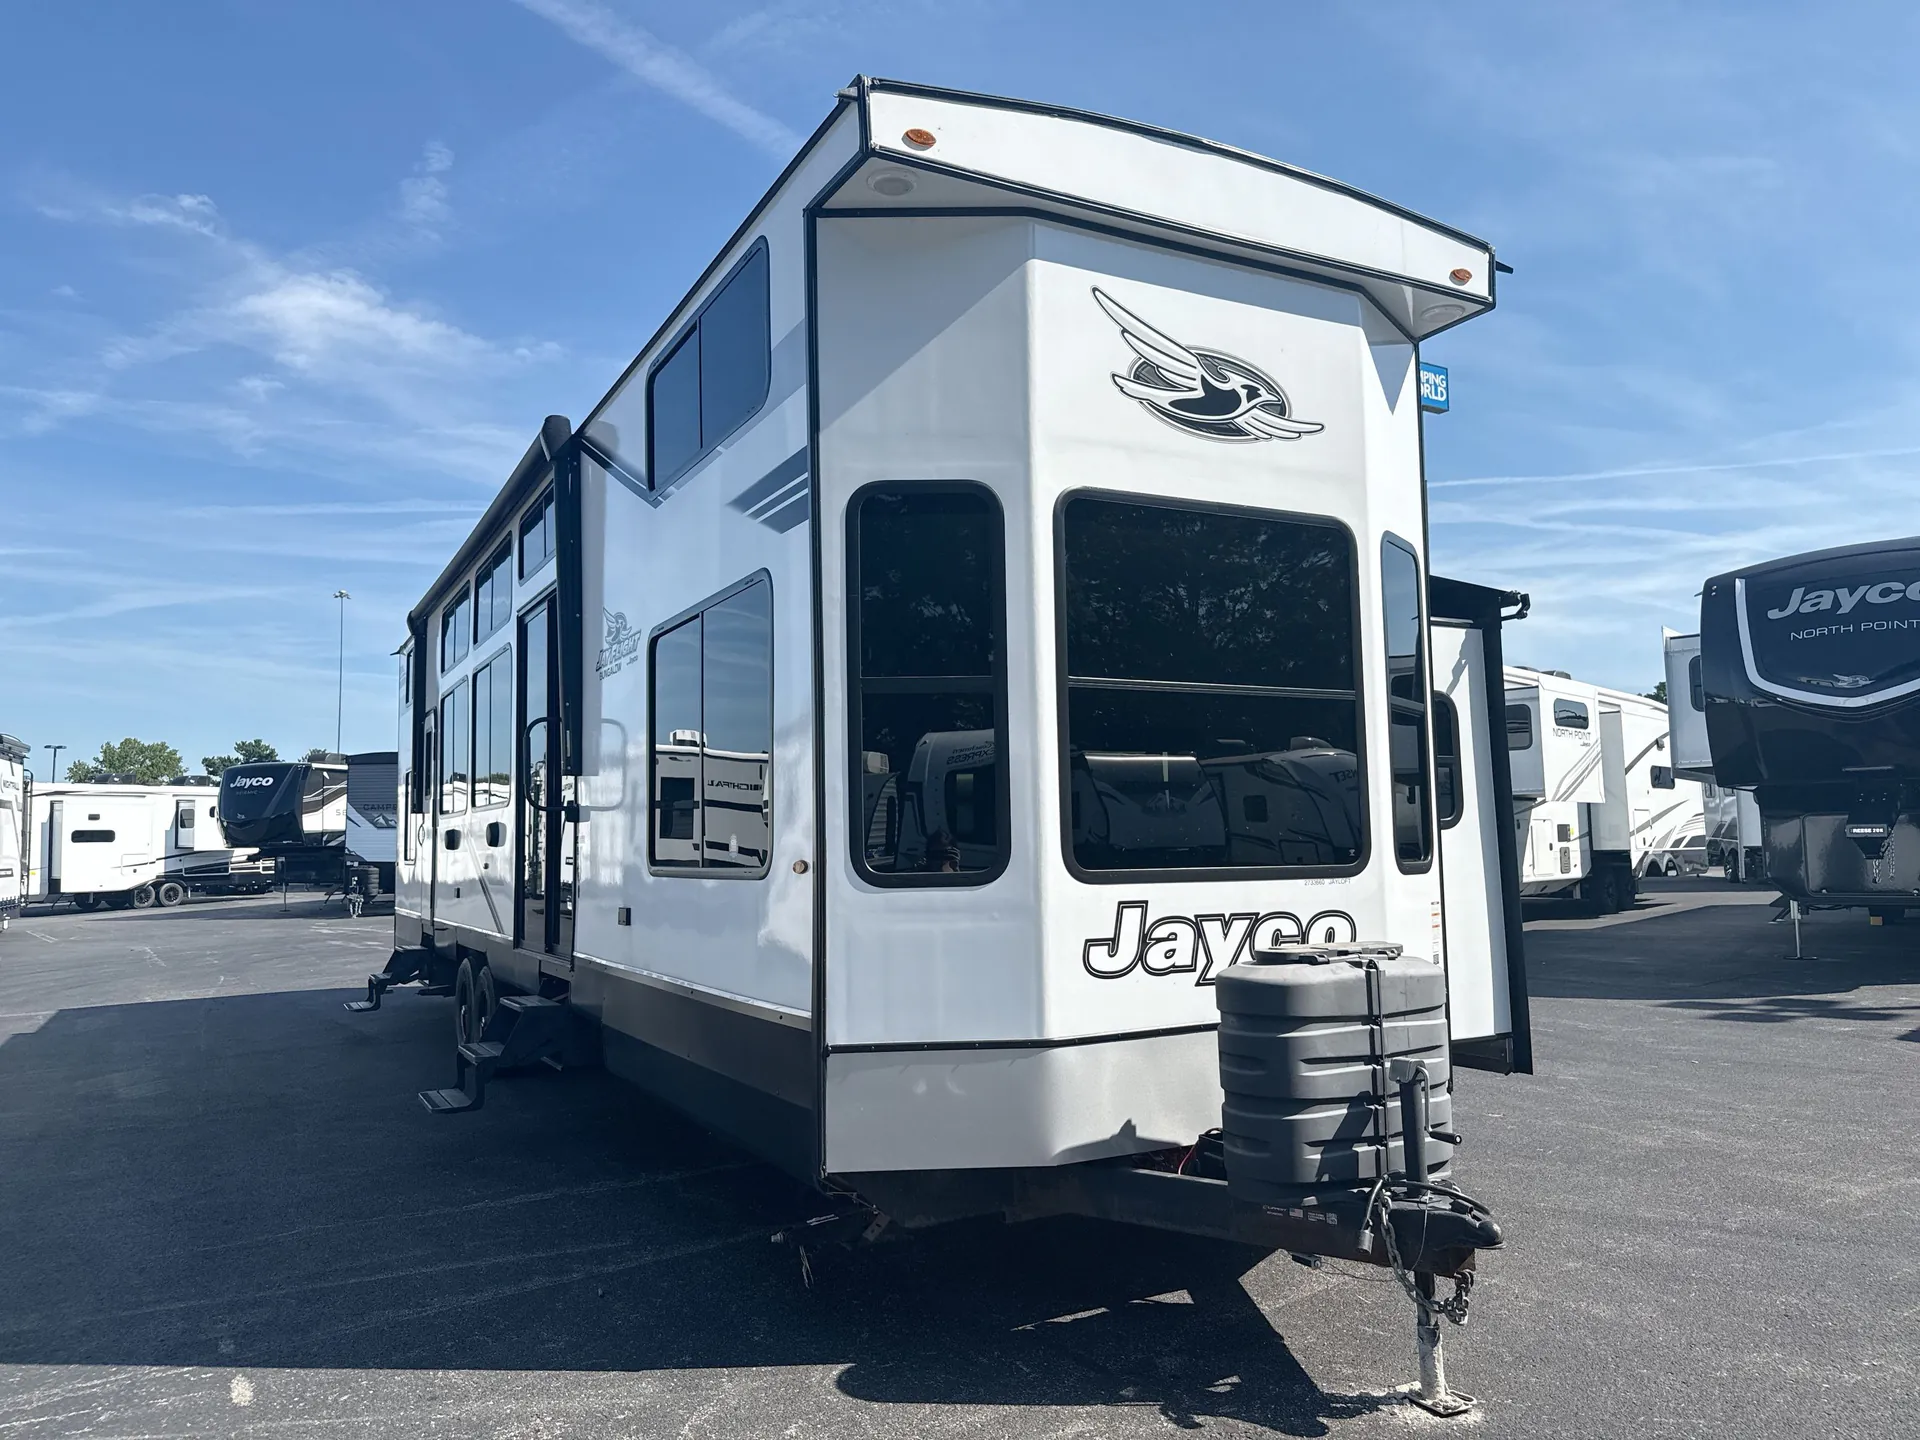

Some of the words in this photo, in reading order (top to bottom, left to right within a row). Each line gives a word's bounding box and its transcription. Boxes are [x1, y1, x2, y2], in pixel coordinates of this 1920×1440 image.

[1790, 624, 1853, 641] NORTH
[1861, 619, 1920, 632] POINT
[599, 661, 622, 681] BUNGALOW
[1552, 727, 1573, 739] NORTH
[1574, 730, 1591, 741] POINT
[229, 775, 274, 789] Jayco
